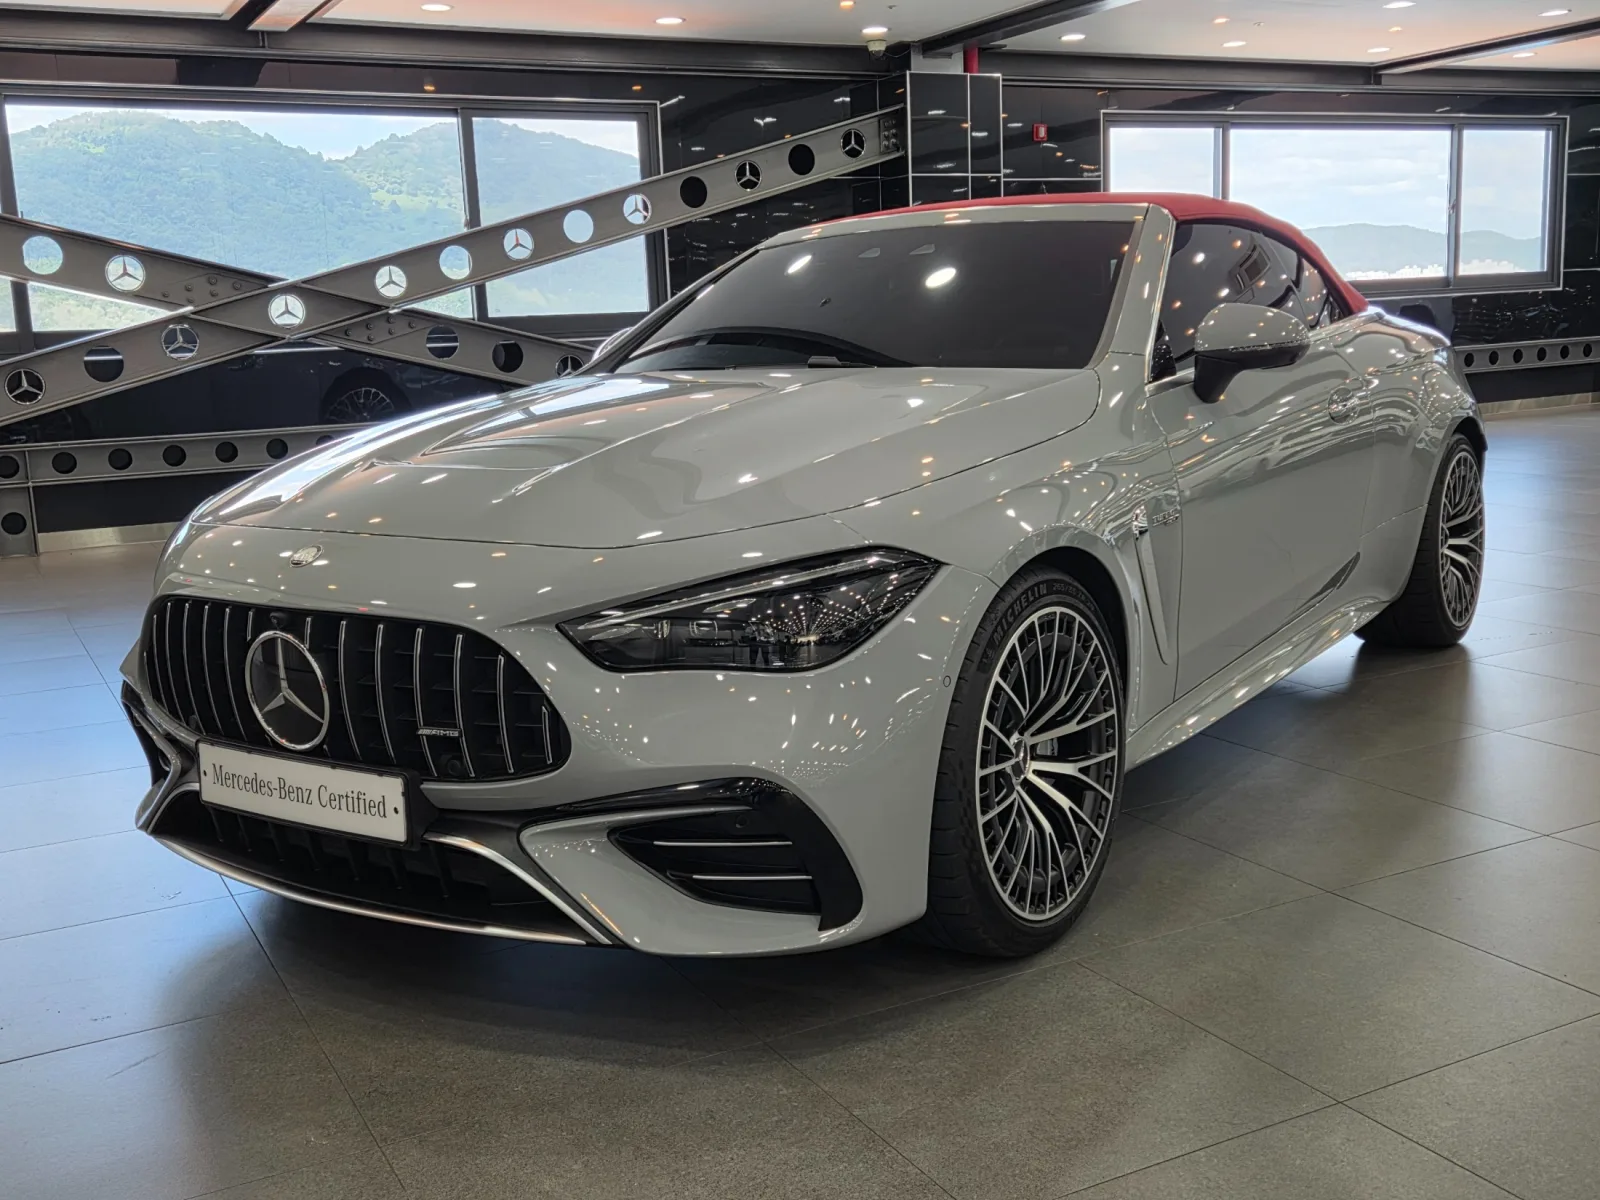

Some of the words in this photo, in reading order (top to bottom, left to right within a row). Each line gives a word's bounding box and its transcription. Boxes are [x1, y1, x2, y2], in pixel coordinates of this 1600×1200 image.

[993, 583, 1048, 645] MICHELIN
[212, 763, 313, 805] Mercedes-Benz
[317, 785, 387, 818] Certified
